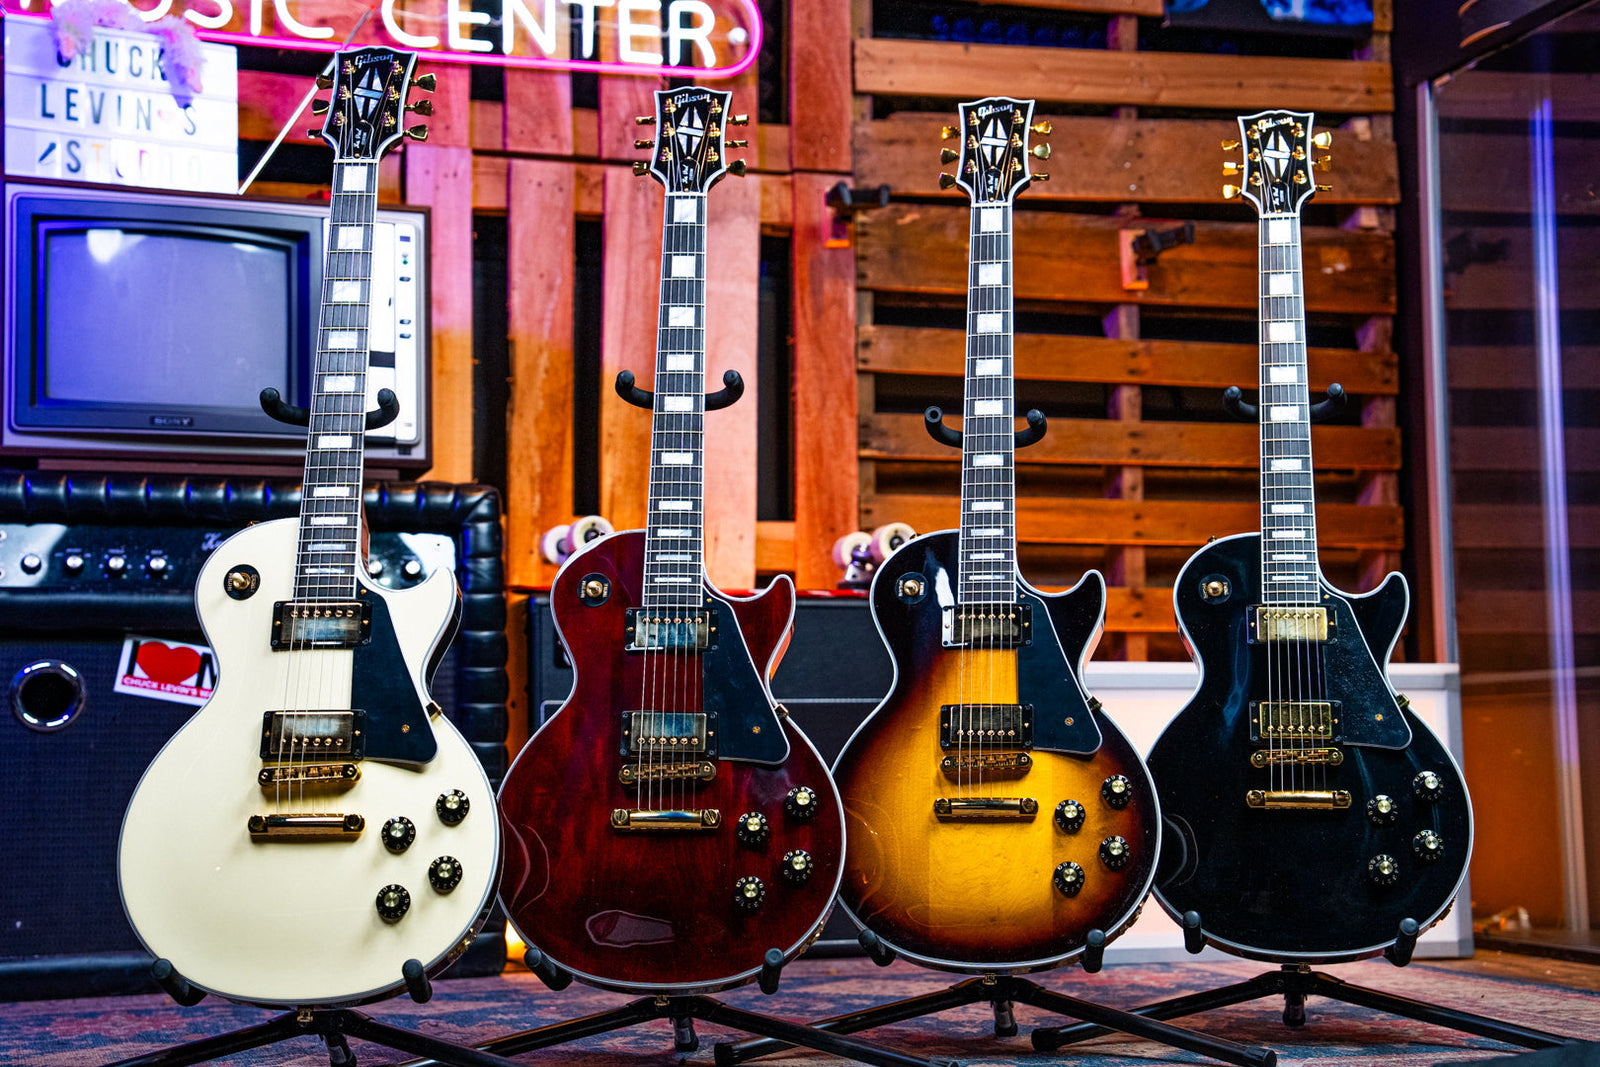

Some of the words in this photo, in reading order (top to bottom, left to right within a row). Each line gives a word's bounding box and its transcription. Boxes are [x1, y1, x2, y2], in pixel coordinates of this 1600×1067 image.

[19, 0, 334, 39] SIC
[381, 0, 717, 68] CENTER
[355, 53, 394, 69] Gibson
[674, 93, 711, 108] Gibson
[978, 103, 1014, 119] Gibson
[1258, 116, 1296, 133] Gibson
[122, 676, 158, 688] CHUCK
[160, 682, 198, 696] LEVIN'S
